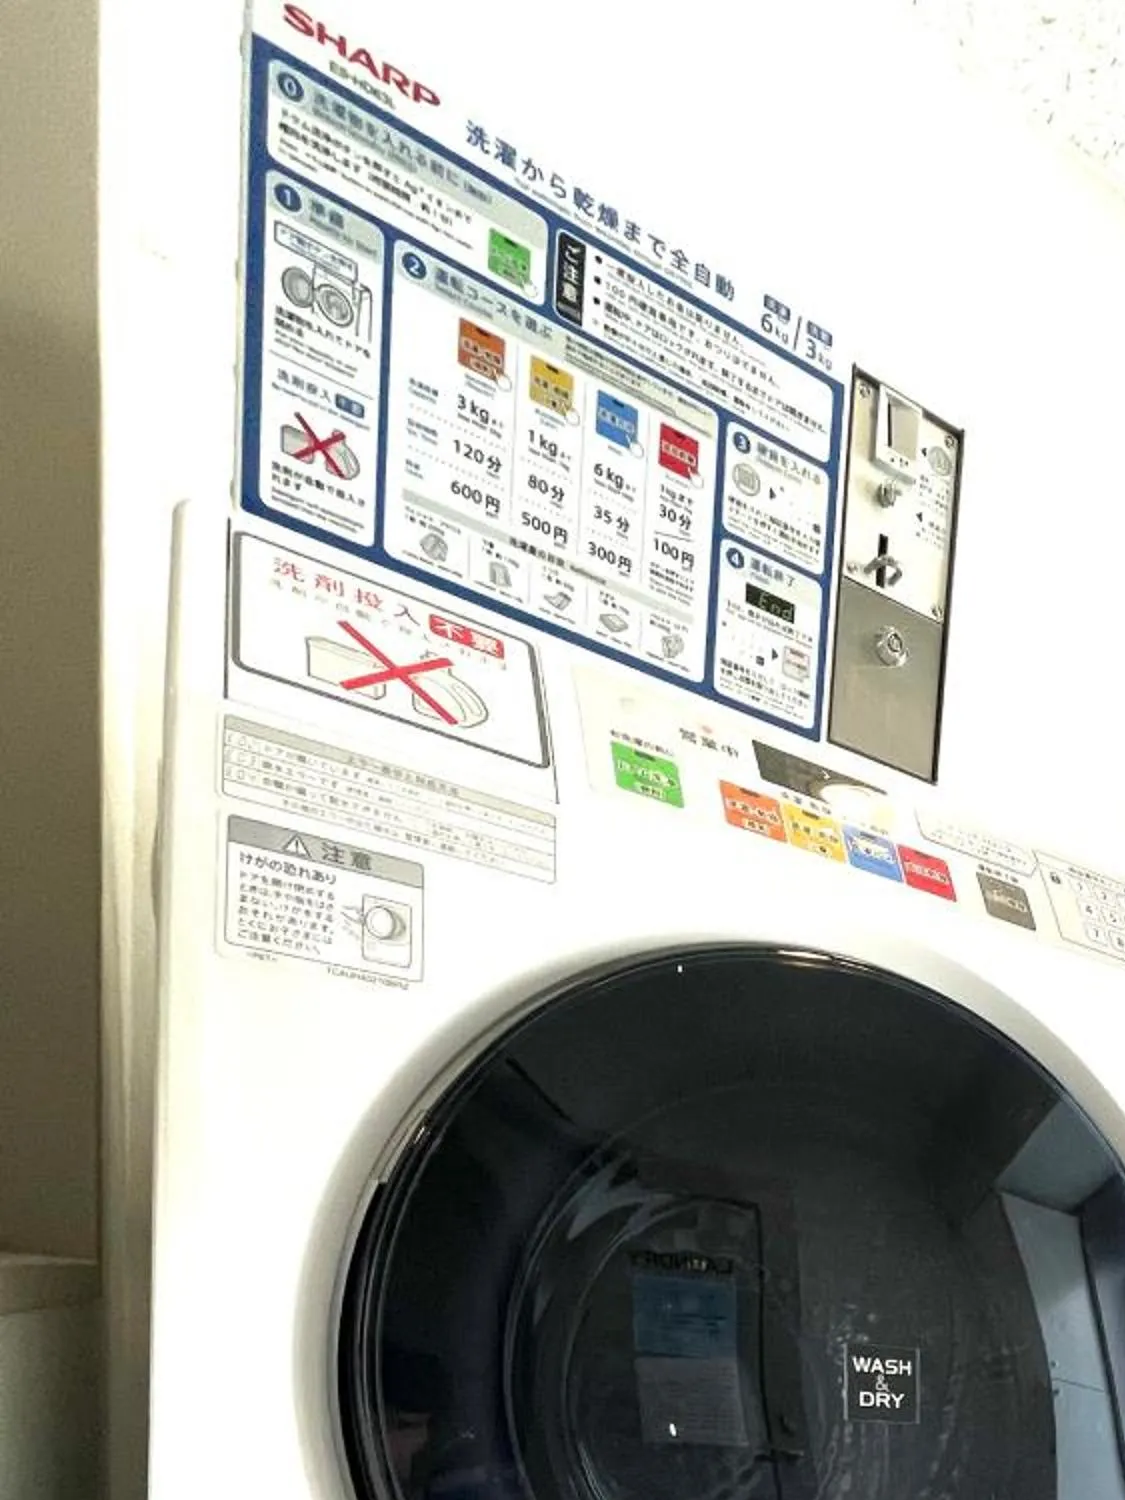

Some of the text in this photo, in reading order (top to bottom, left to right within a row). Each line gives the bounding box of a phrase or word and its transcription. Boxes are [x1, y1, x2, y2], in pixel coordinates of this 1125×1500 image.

[282, 3, 441, 107] SHARP
[465, 119, 735, 301] 洗濯から乾燥まで全自動
[452, 436, 501, 475] 120分
[450, 477, 500, 514] 600円
[527, 472, 565, 504] 80分
[521, 509, 568, 545] 500円
[593, 503, 629, 534] 35分
[658, 502, 691, 531] 30分
[587, 539, 632, 574] 300円
[653, 536, 694, 569] 100円
[239, 850, 337, 887] けがの恐れあり
[321, 841, 372, 872] 注意
[852, 1356, 912, 1376] WASH
[875, 1374, 889, 1392] &
[859, 1391, 905, 1409] DRY
